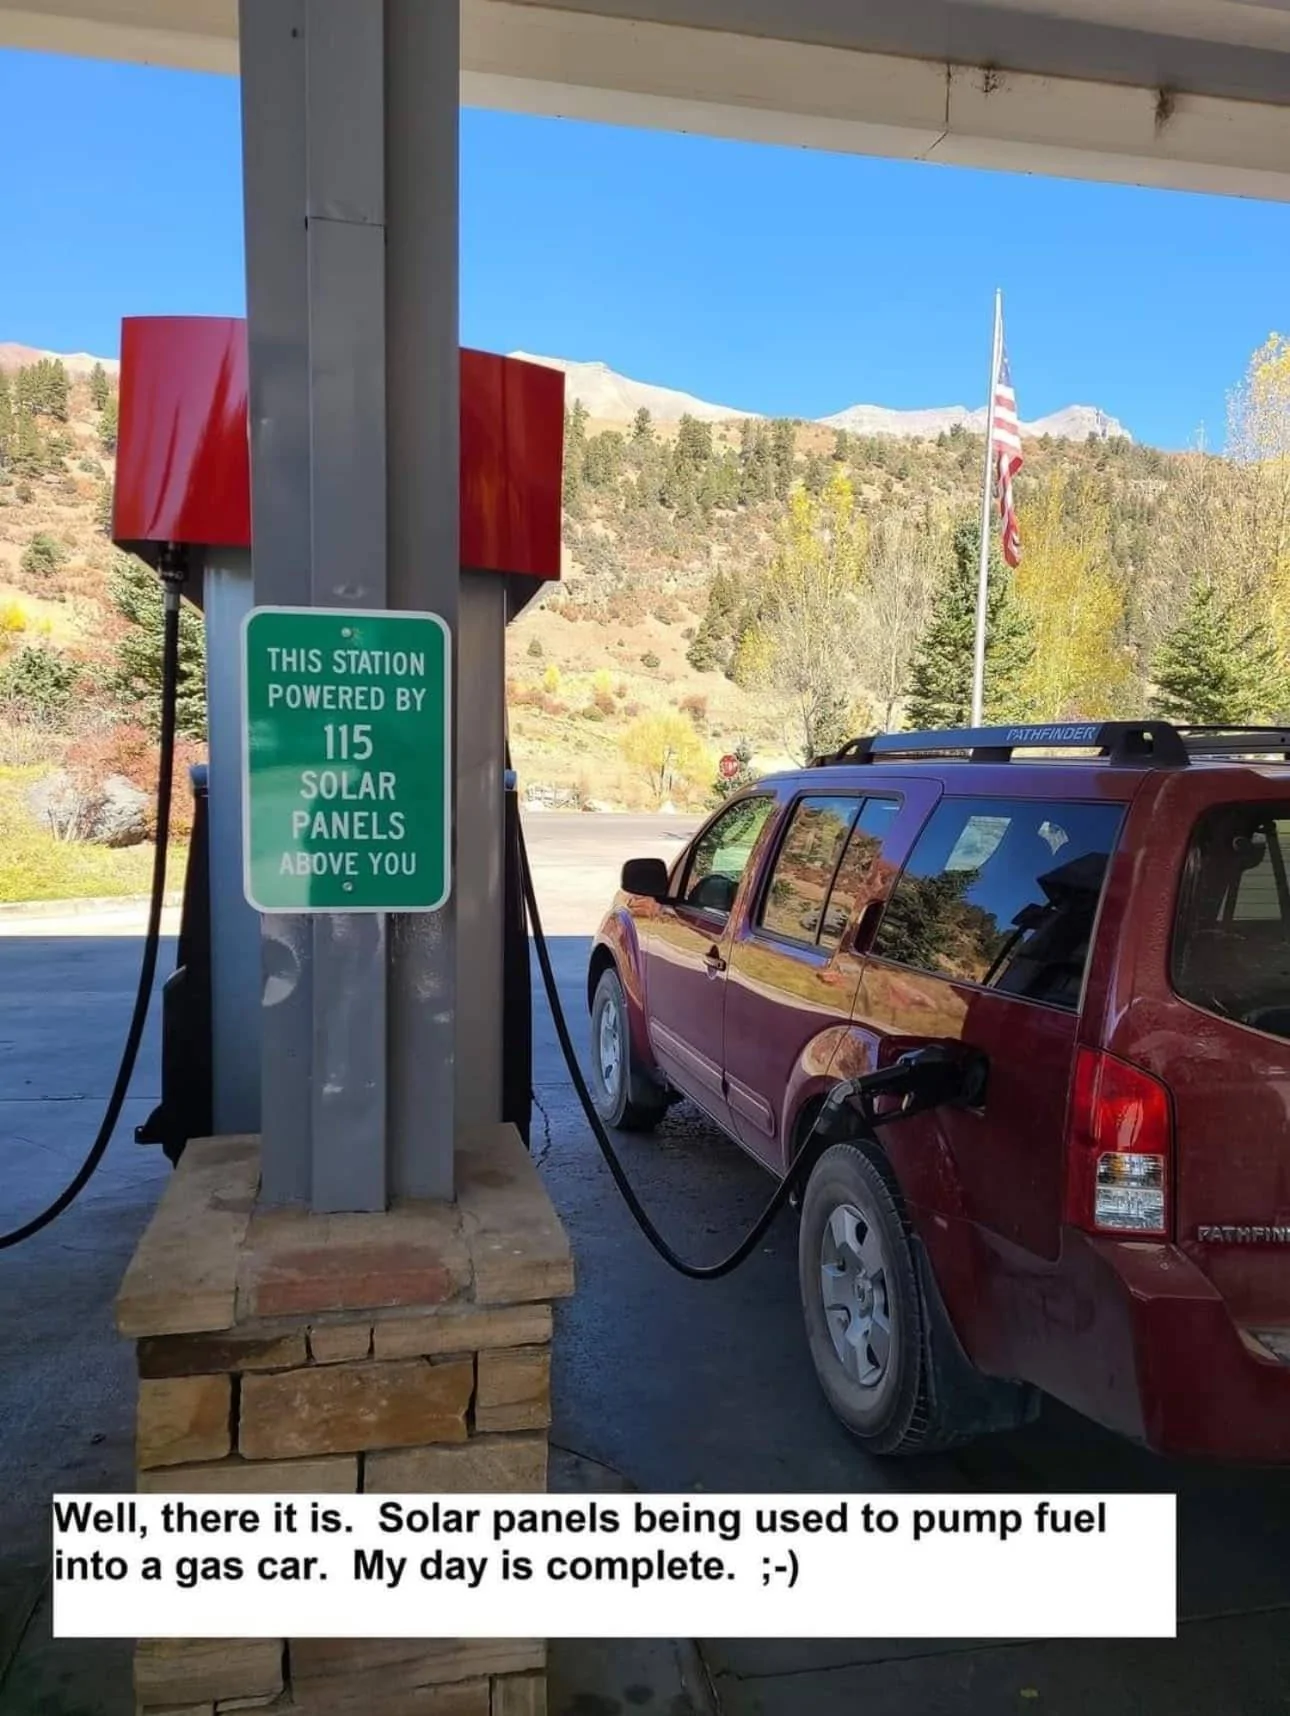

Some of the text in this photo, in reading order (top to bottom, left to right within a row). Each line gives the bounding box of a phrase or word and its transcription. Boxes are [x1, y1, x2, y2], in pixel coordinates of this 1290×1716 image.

[267, 647, 425, 677] THIS STATION
[268, 684, 427, 712] POWERED BY
[323, 724, 374, 761] 115
[1006, 726, 1097, 741] PATHFINDER
[300, 770, 397, 801] SOLAR
[292, 811, 406, 840] PANELS
[279, 852, 417, 876] ABOVE YOU
